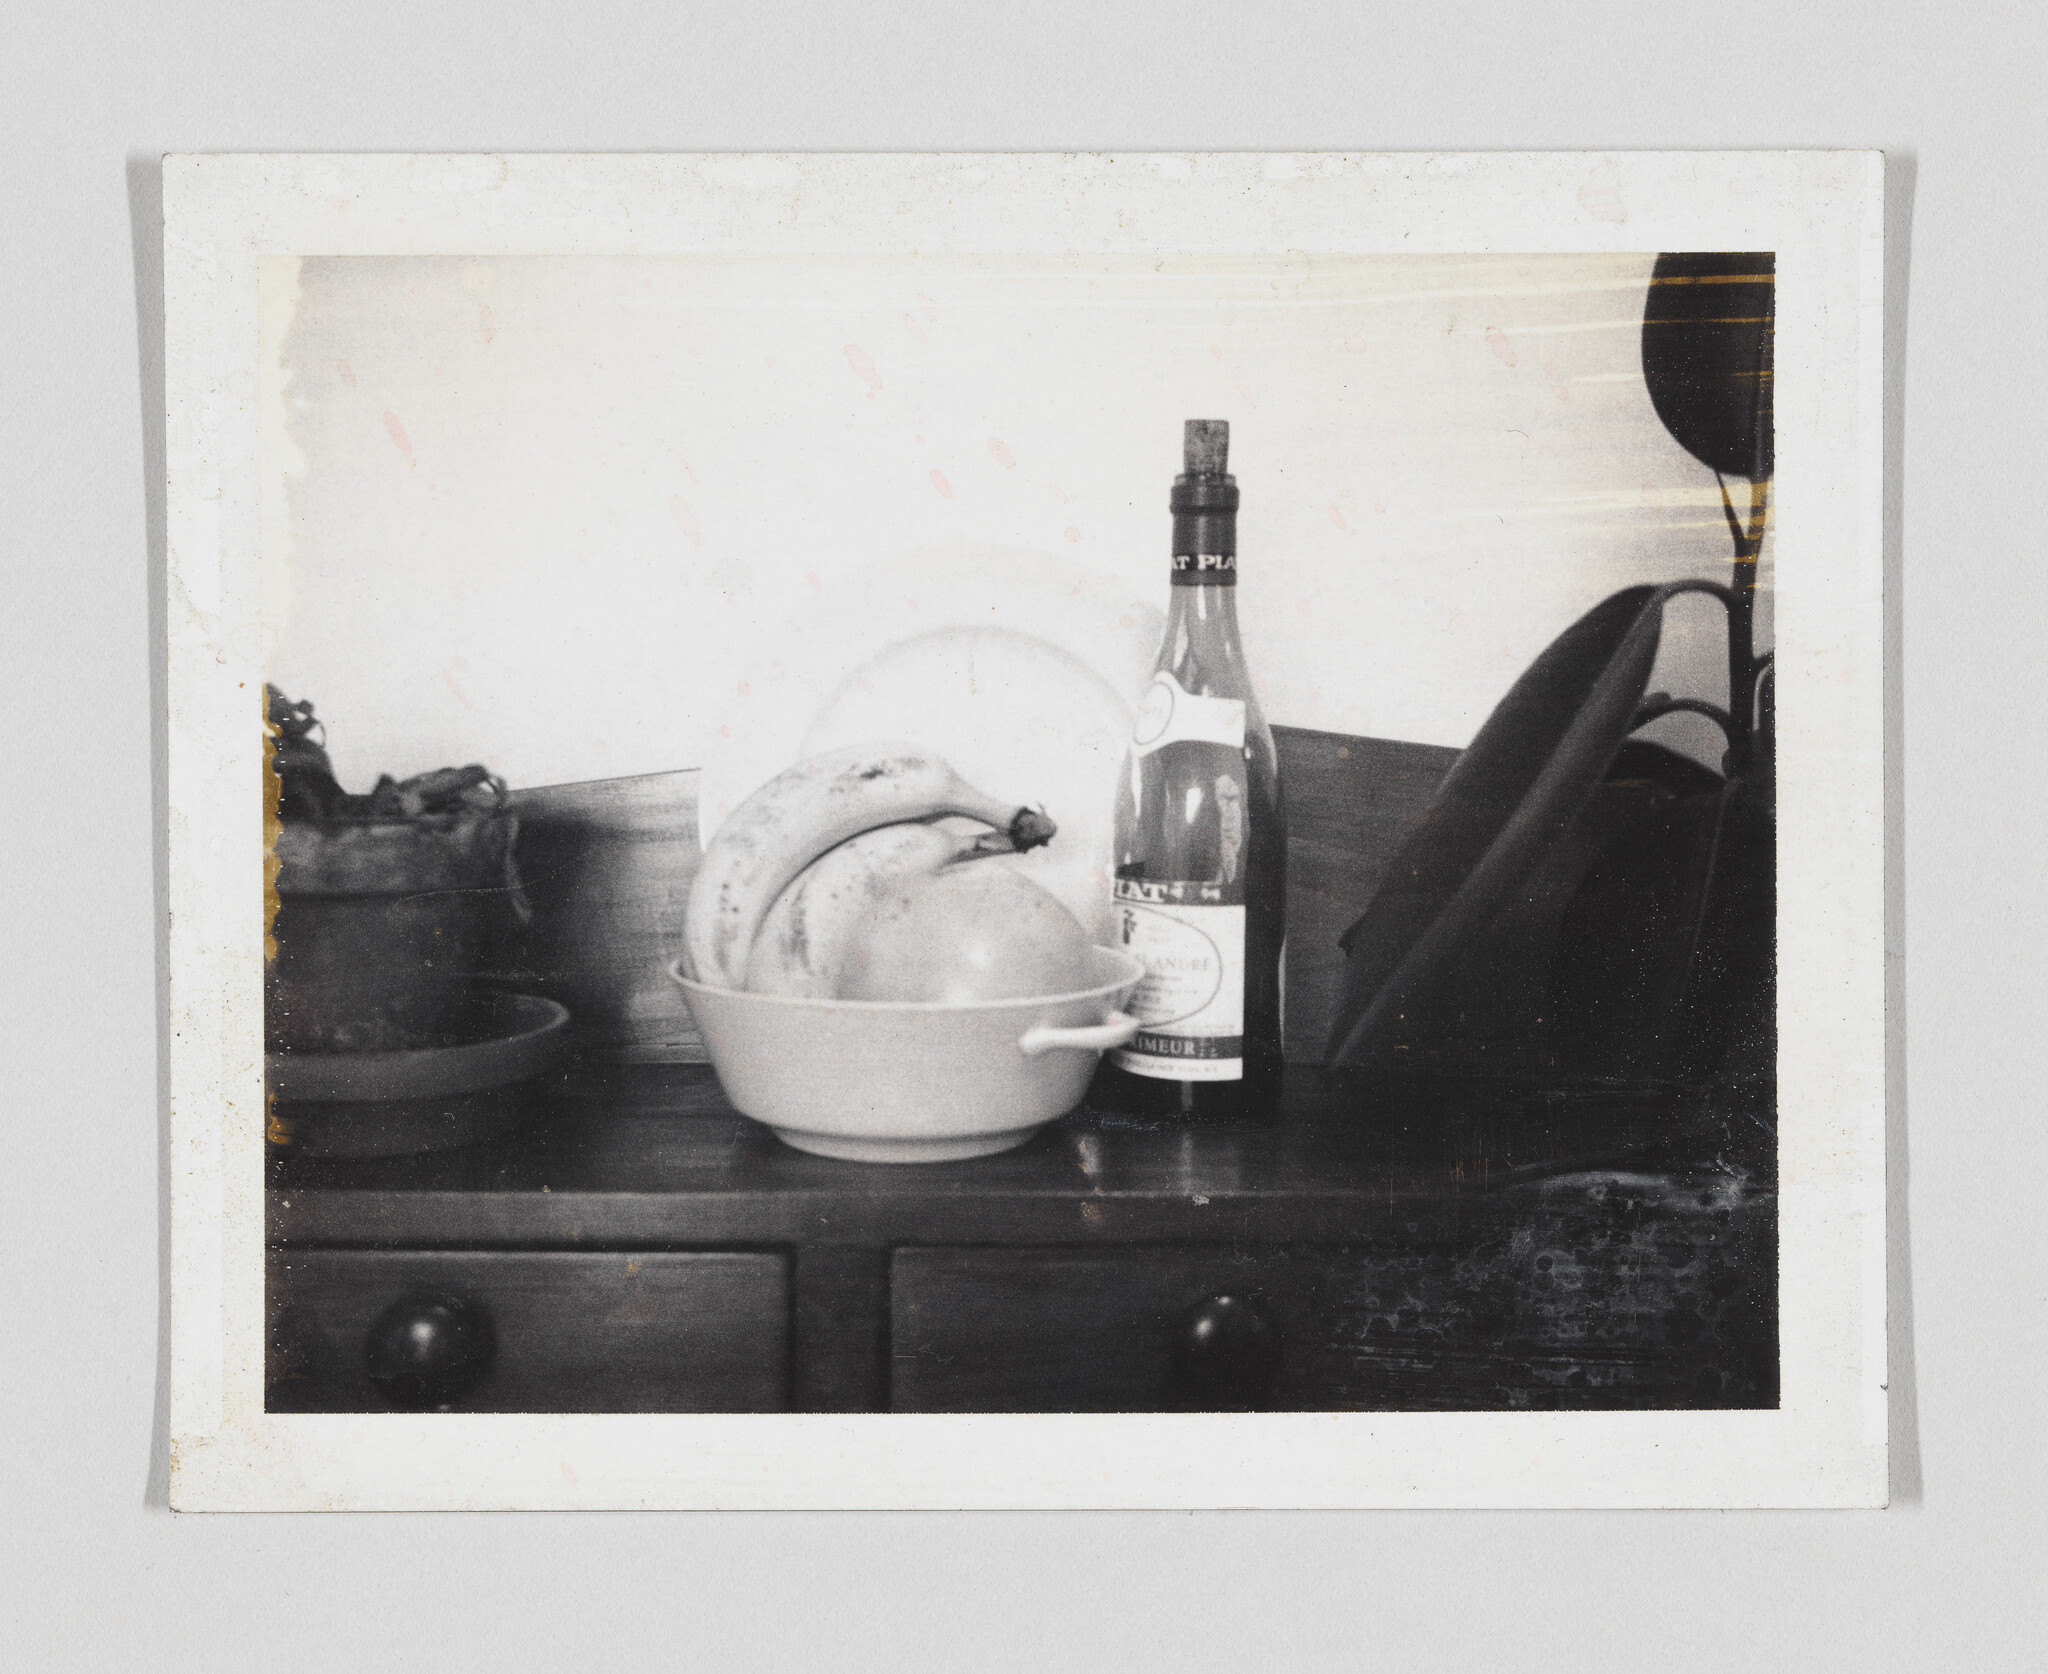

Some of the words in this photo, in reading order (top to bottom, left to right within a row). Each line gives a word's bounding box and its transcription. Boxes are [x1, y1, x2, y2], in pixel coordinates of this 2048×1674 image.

[1171, 555, 1190, 570] AT
[1197, 554, 1236, 570] PIA
[1115, 879, 1168, 903] IAT
[1136, 1037, 1195, 1056] IMEUR
